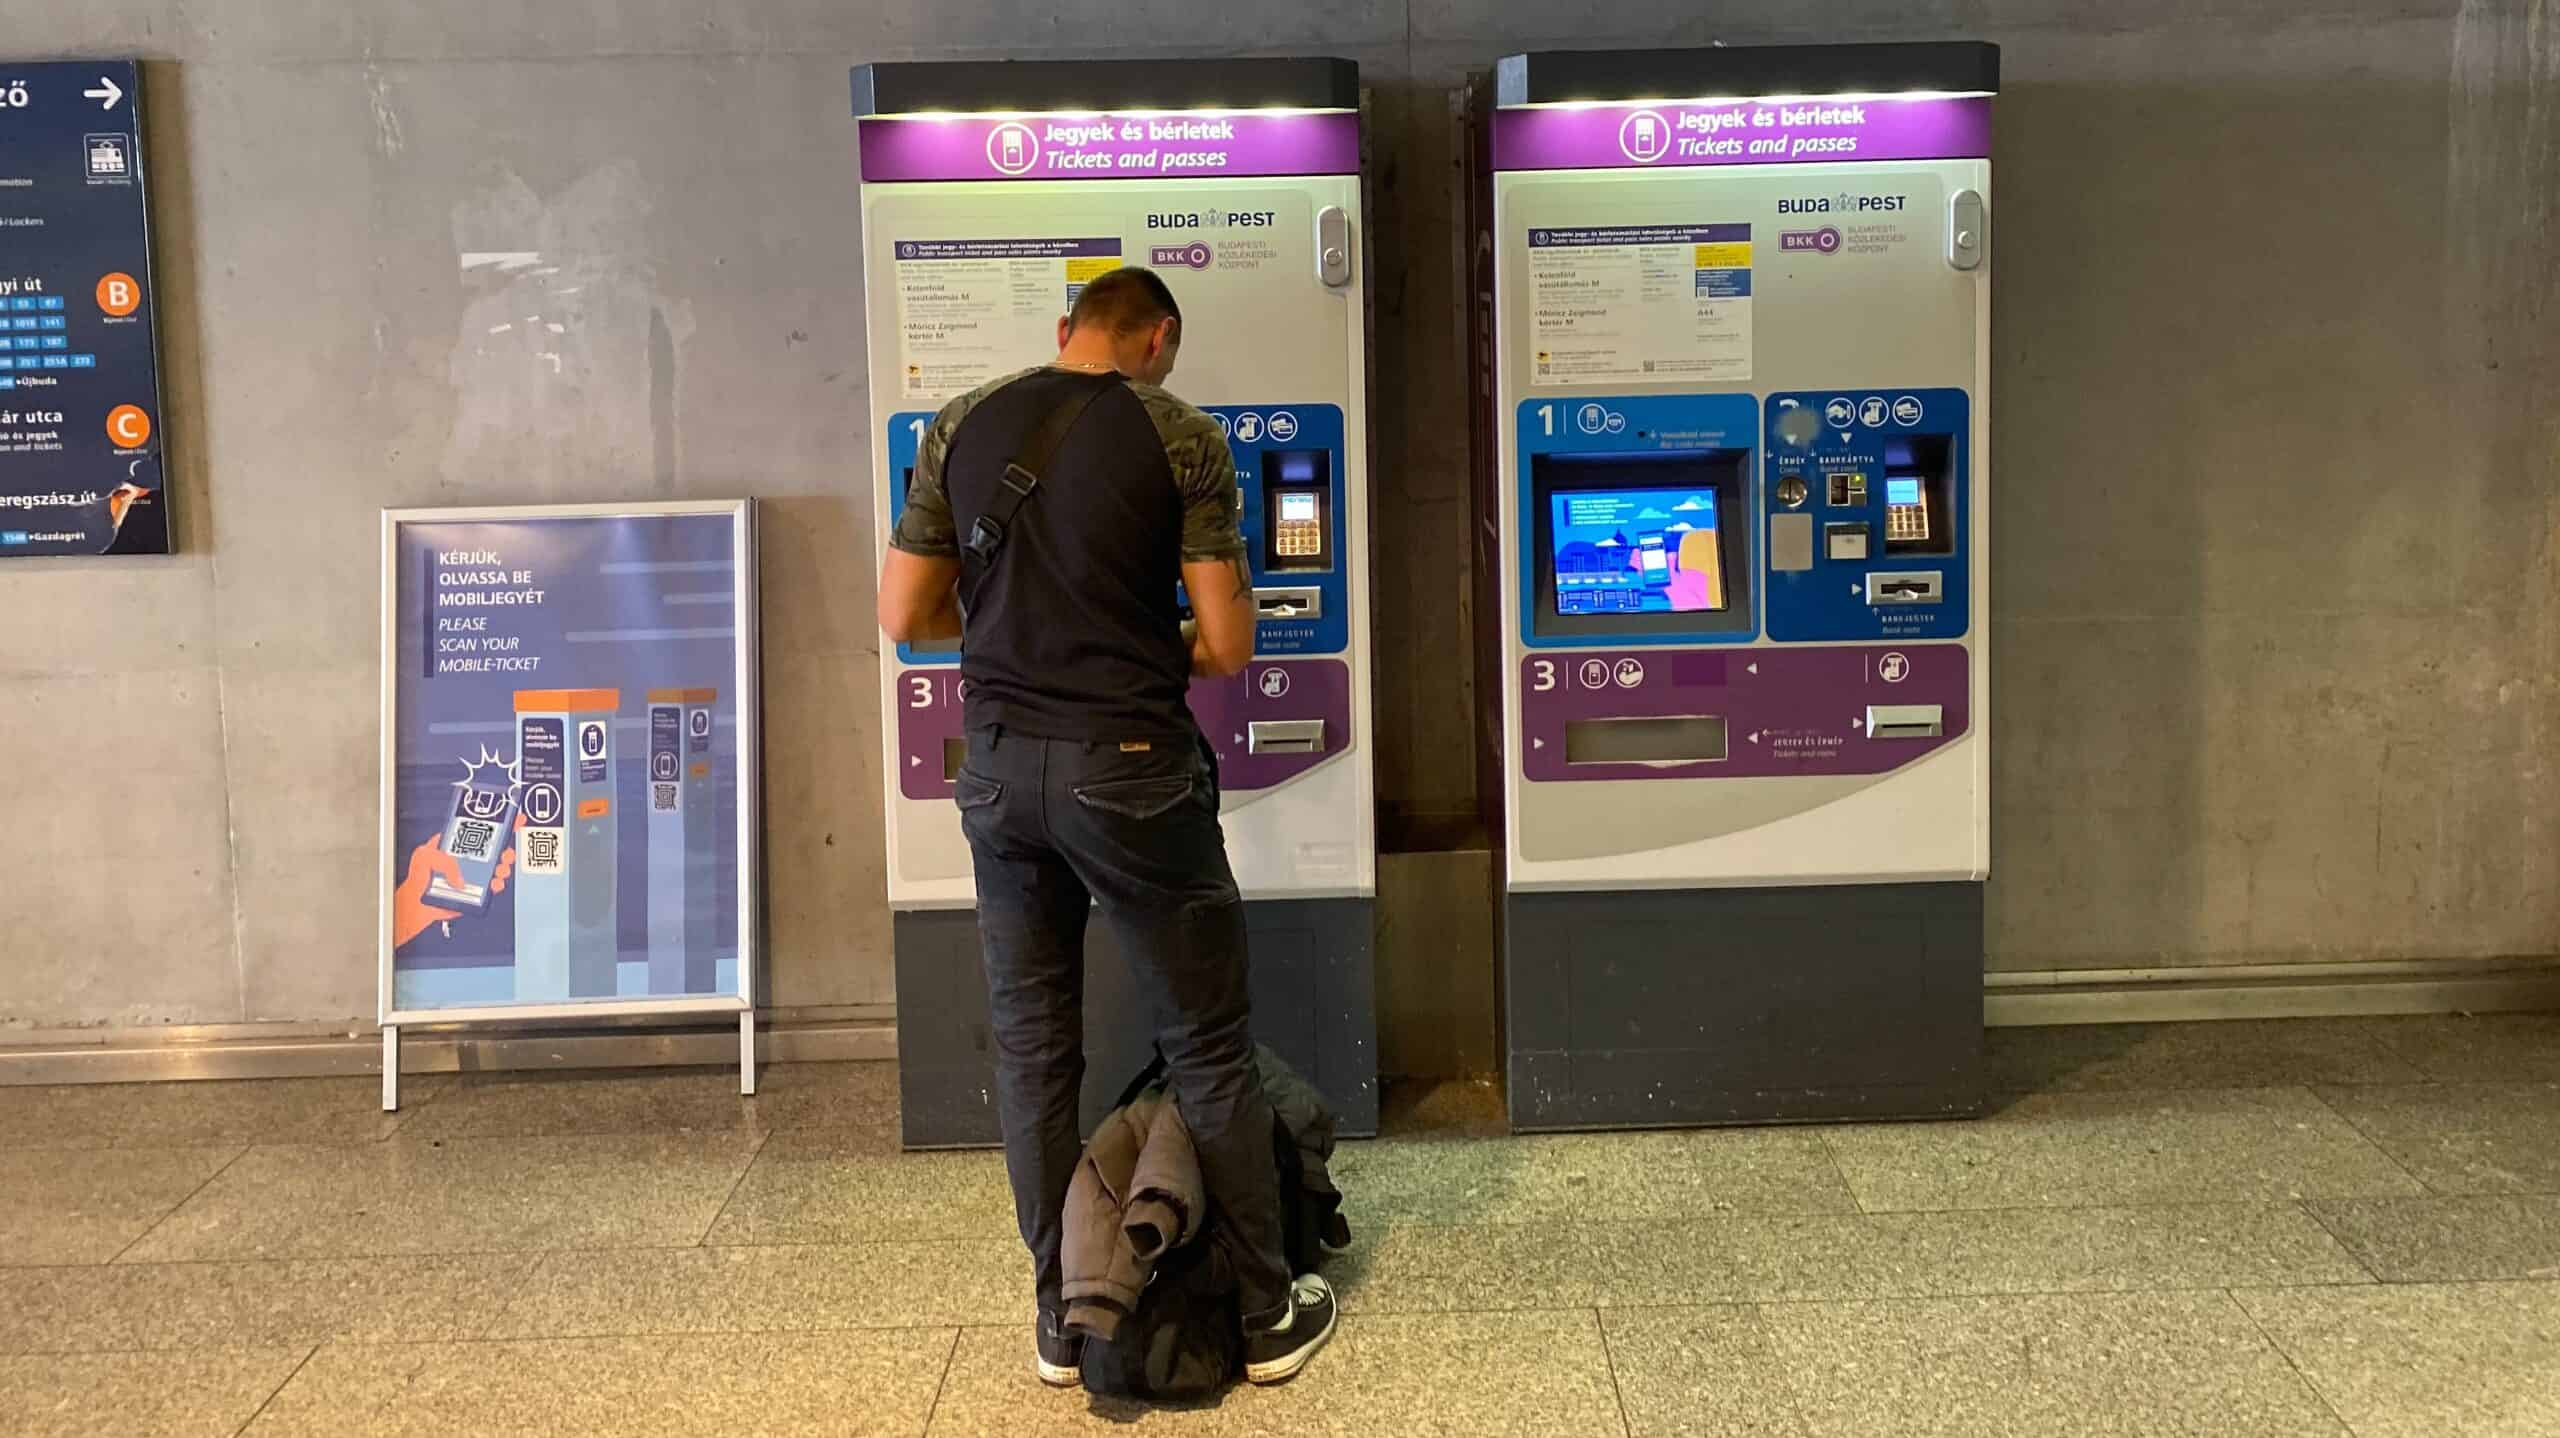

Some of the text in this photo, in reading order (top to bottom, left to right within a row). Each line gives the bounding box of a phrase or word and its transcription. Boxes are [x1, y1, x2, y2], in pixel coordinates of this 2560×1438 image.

[1677, 106, 1866, 134] Jegyek és bérletek
[1044, 119, 1235, 147] Jegyek és bérletek
[1677, 136, 1857, 158] Tickets and passes
[1046, 149, 1227, 171] Tickets and passes
[1787, 236, 1814, 247] BKK
[1158, 251, 1185, 262] BKK
[24, 276, 42, 292] út
[108, 281, 129, 306] B
[26, 411, 63, 423] utca
[118, 413, 138, 438] C
[1537, 405, 1553, 435] 1
[1819, 453, 1874, 464] BANKKÁRTYA
[80, 490, 97, 505] út
[439, 549, 501, 566] KÉRJÜK,
[439, 570, 532, 586] OLVASSA BE
[439, 588, 545, 606] MOBILJEGYÉT
[439, 617, 488, 631] PLEASE
[439, 637, 520, 652] SCAN YOUR
[439, 657, 541, 672] MOBILE-TICKET
[1533, 660, 1555, 691] 3
[910, 677, 933, 708] 3
